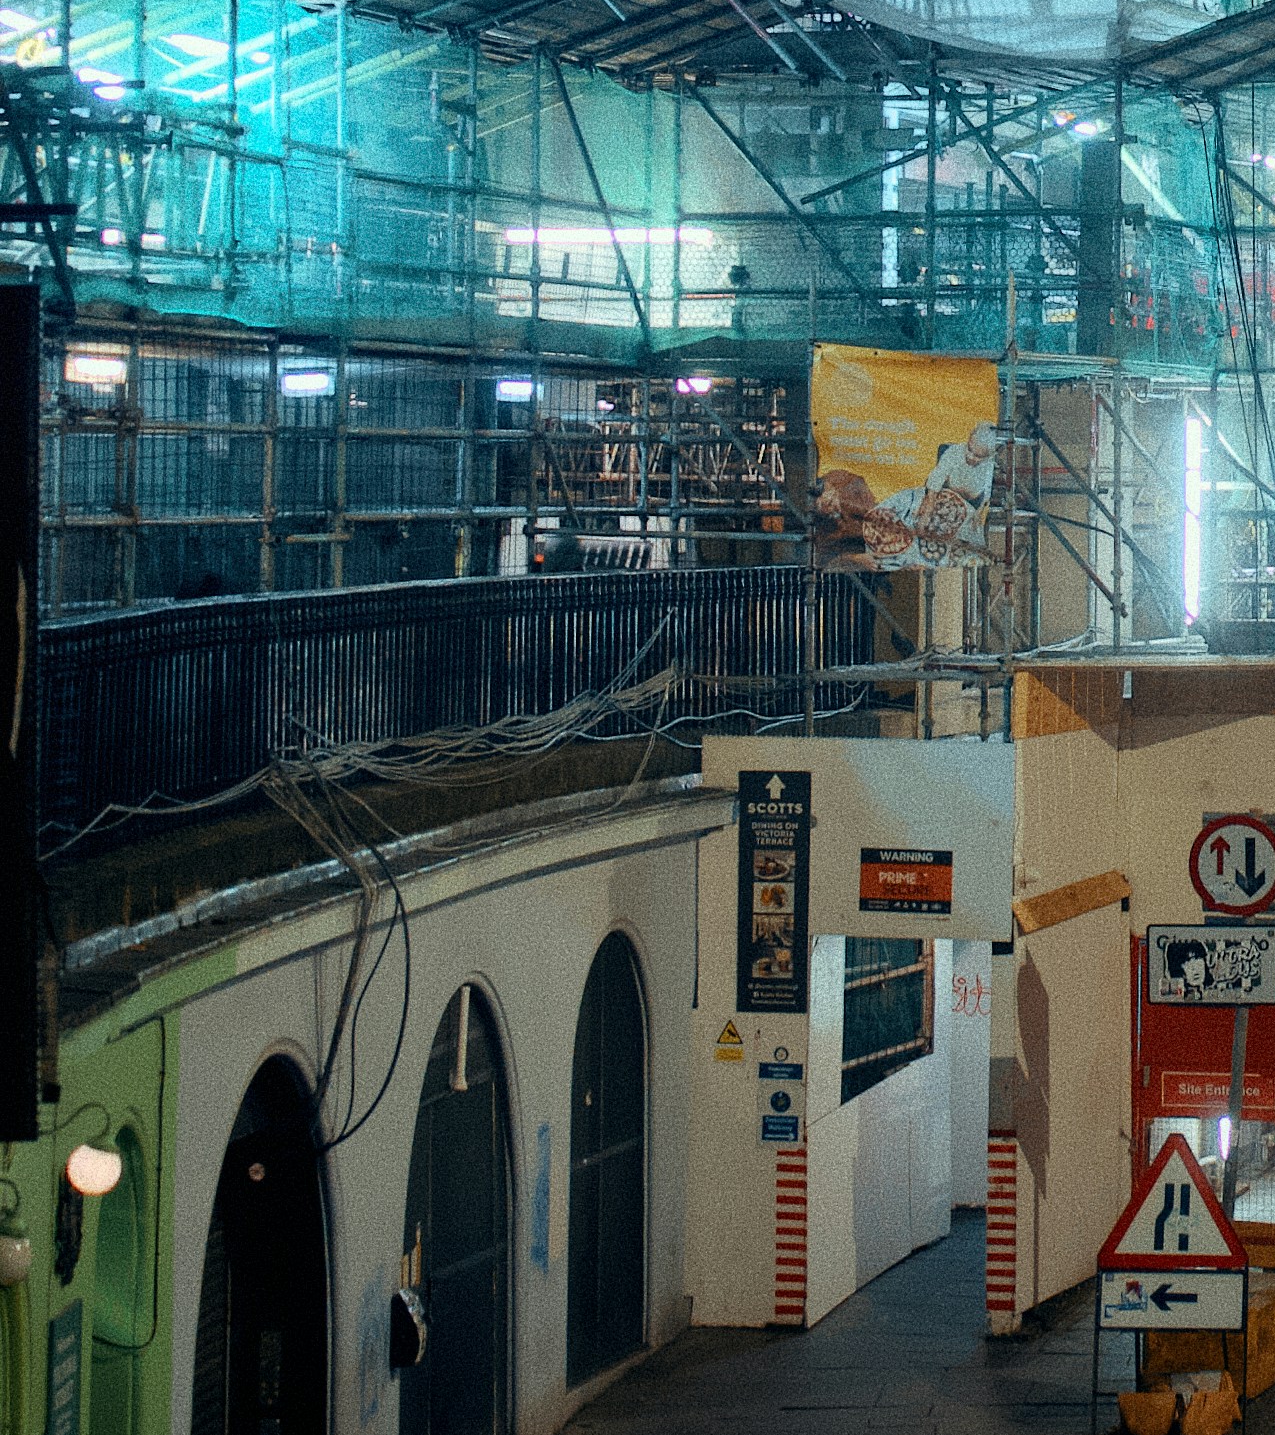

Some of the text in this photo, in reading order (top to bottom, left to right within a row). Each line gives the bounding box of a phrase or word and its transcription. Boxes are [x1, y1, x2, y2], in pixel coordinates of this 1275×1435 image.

[747, 802, 804, 815] SCOTTS
[751, 821, 799, 830] DINING ON
[754, 830, 795, 838] VICTORIA
[756, 837, 793, 846] TERRACE
[879, 850, 934, 863] WARNING
[878, 871, 917, 885] PRIME
[1178, 1082, 1260, 1097] Site Entrce
